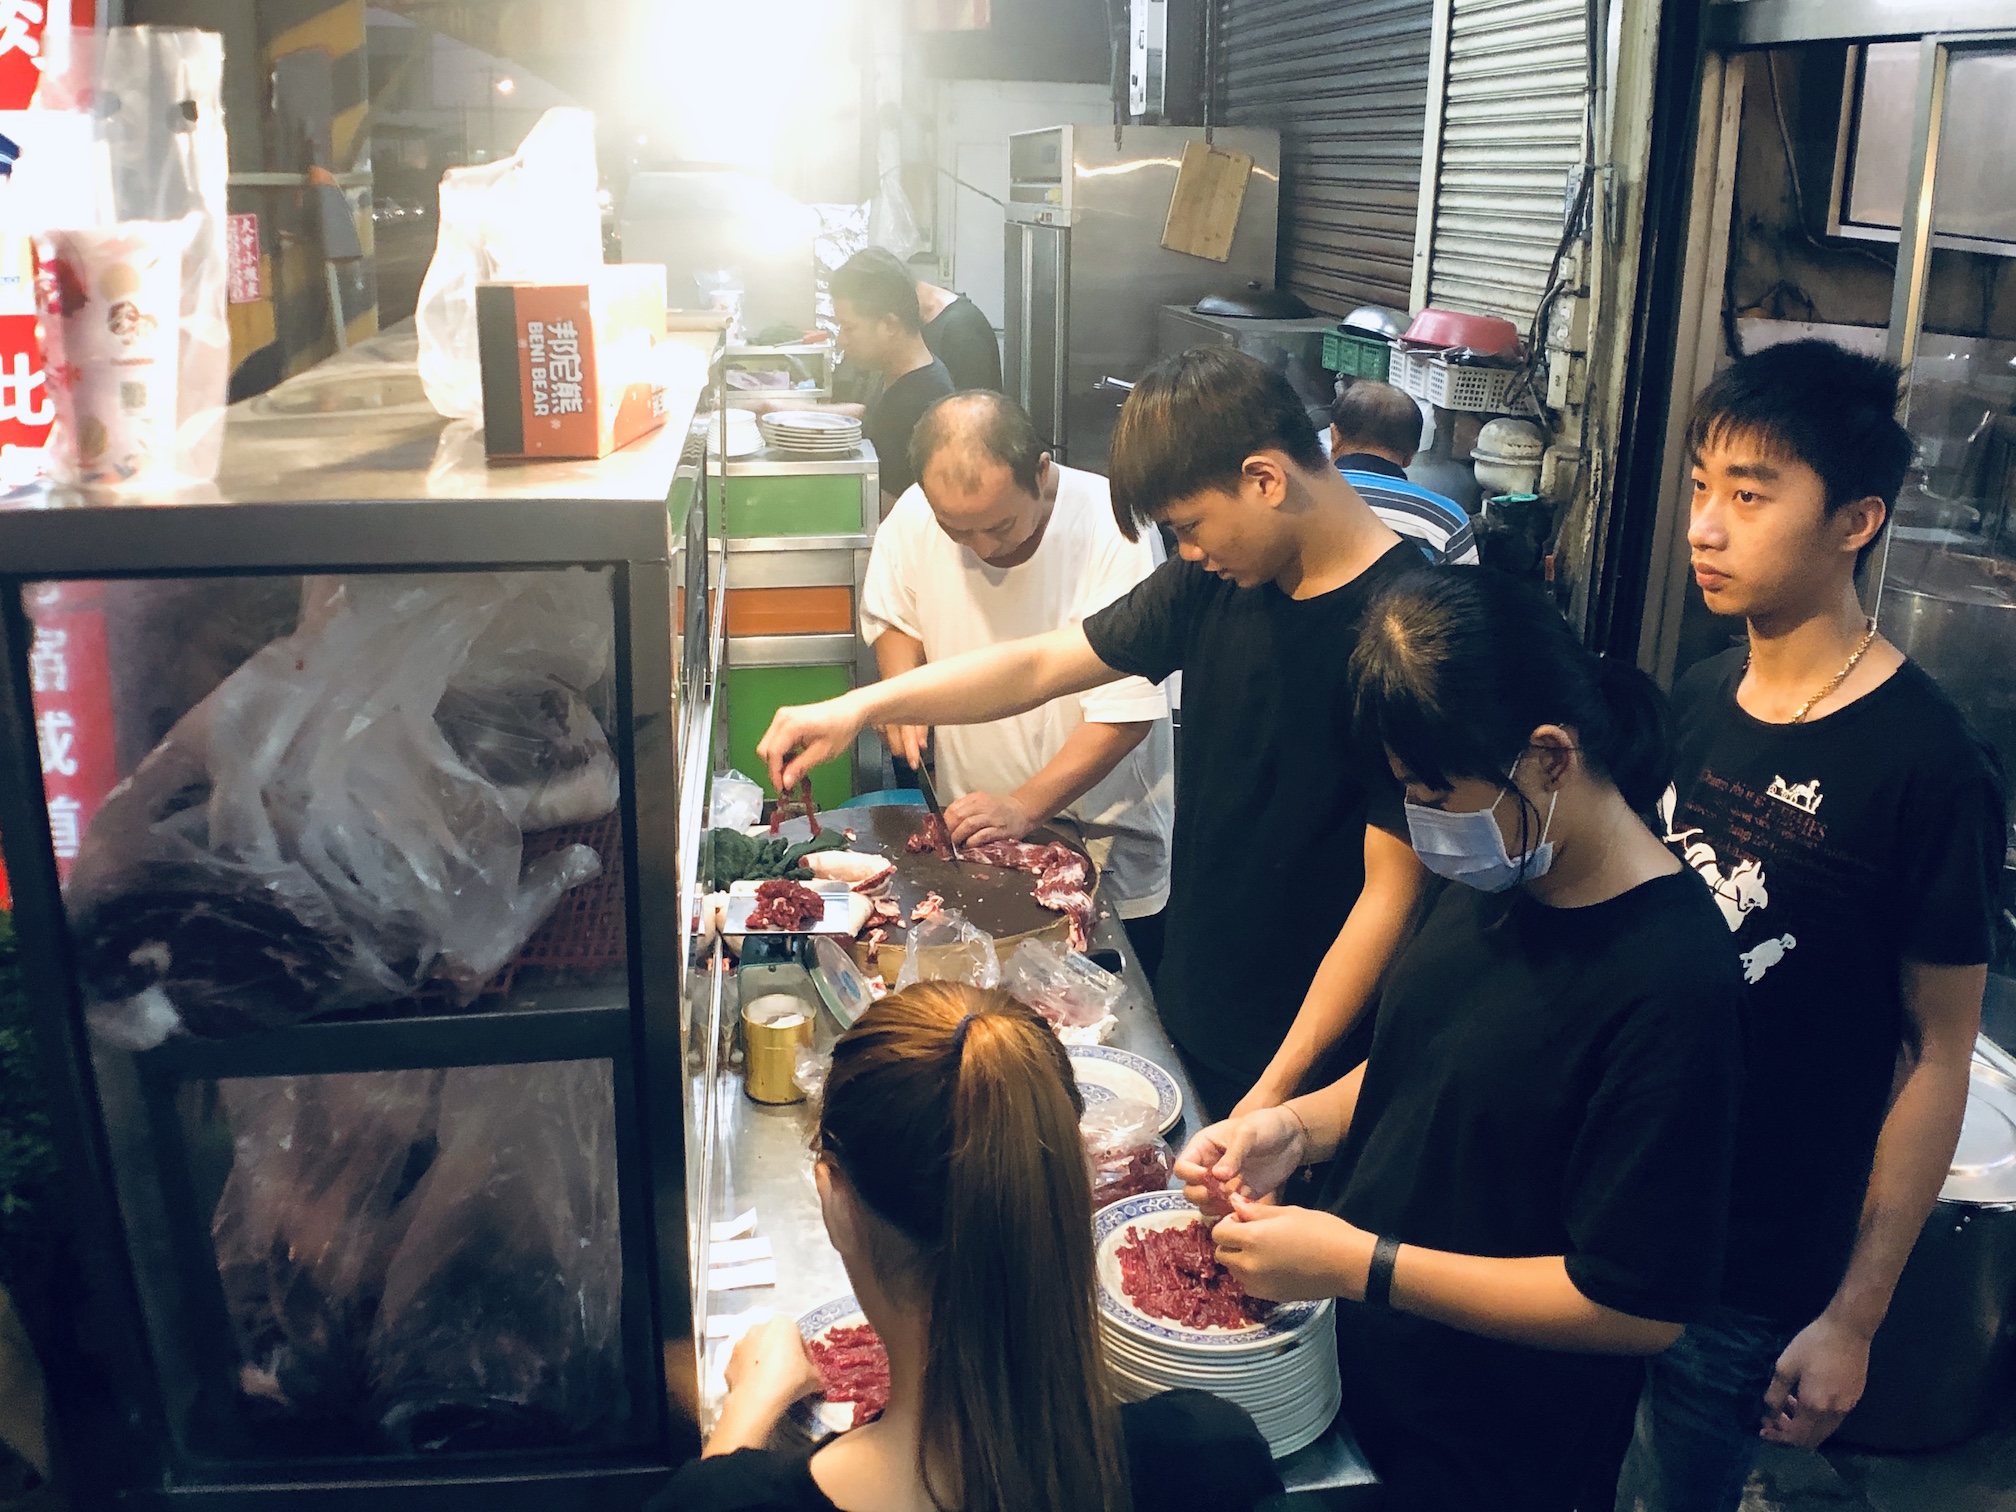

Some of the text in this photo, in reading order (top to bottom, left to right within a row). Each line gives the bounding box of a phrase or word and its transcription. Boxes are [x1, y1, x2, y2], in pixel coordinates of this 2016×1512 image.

[527, 321, 549, 417] BENI BEAR
[547, 320, 583, 414] 邦尼熊
